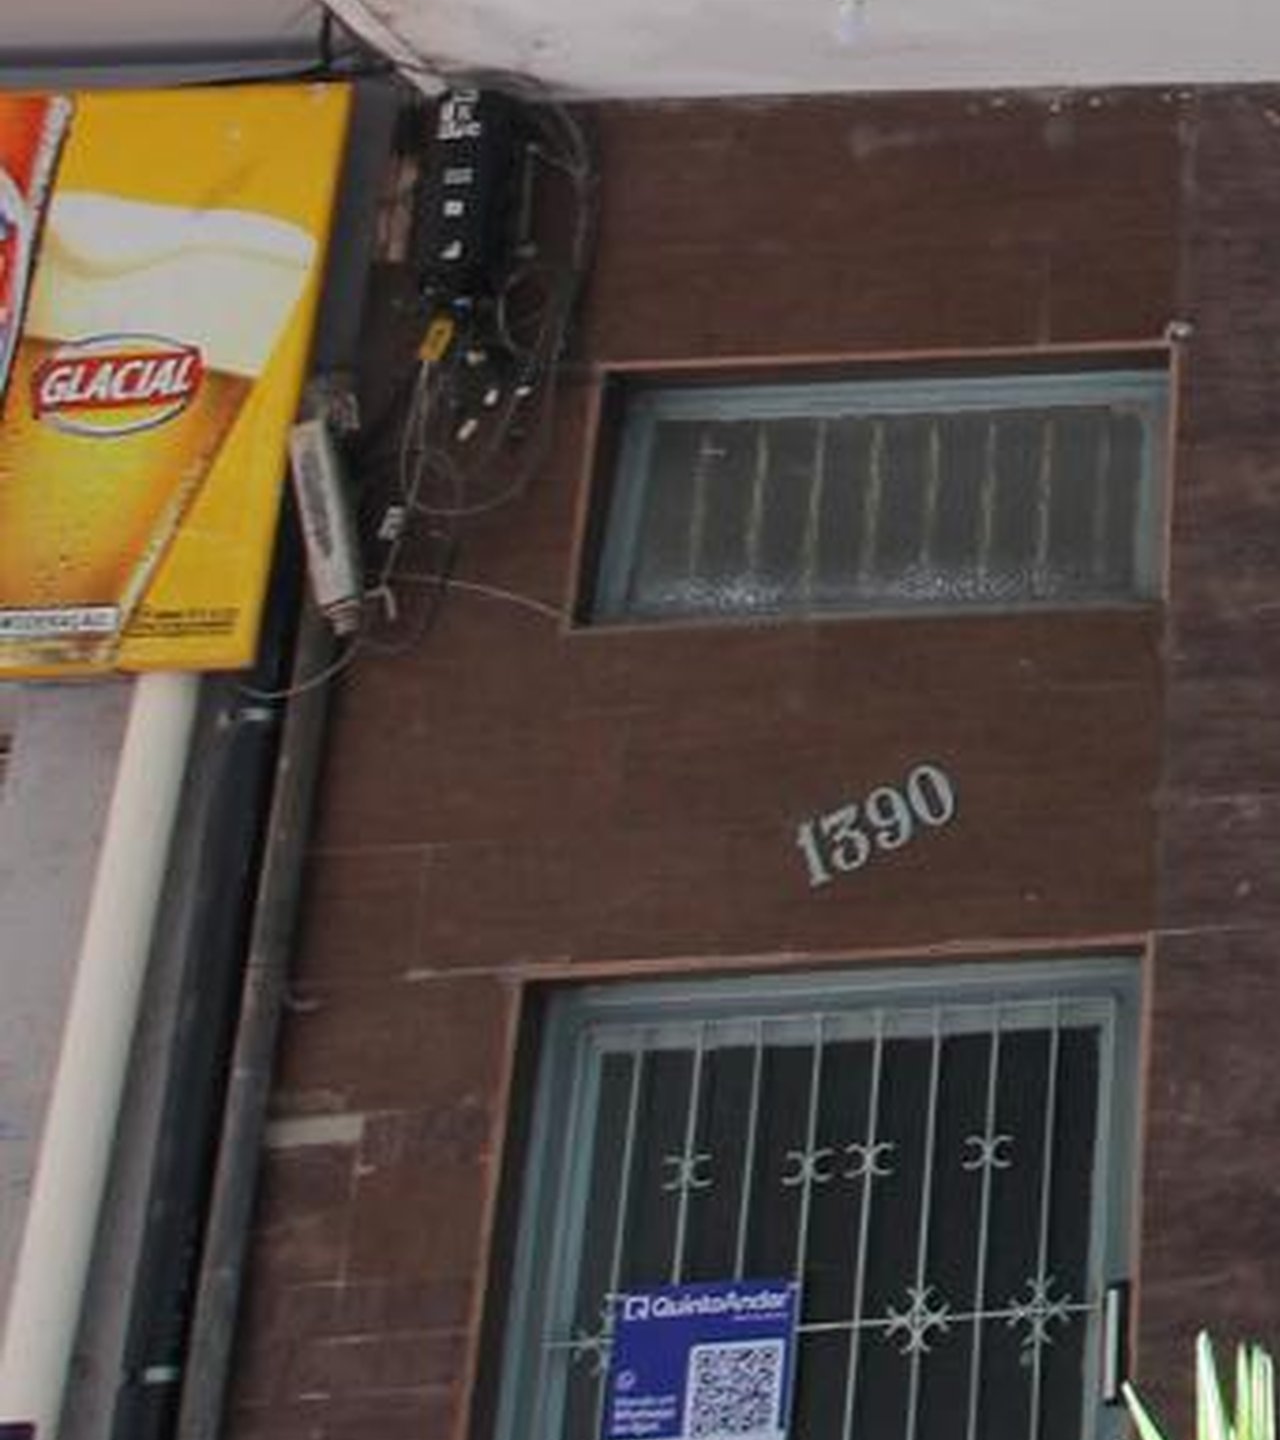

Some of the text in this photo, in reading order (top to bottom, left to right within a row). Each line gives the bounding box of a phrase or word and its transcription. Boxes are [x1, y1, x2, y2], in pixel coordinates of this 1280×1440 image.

[40, 356, 193, 403] GLACIAL
[796, 765, 955, 887] 1390
[652, 1291, 788, 1319] QuintoAndar
